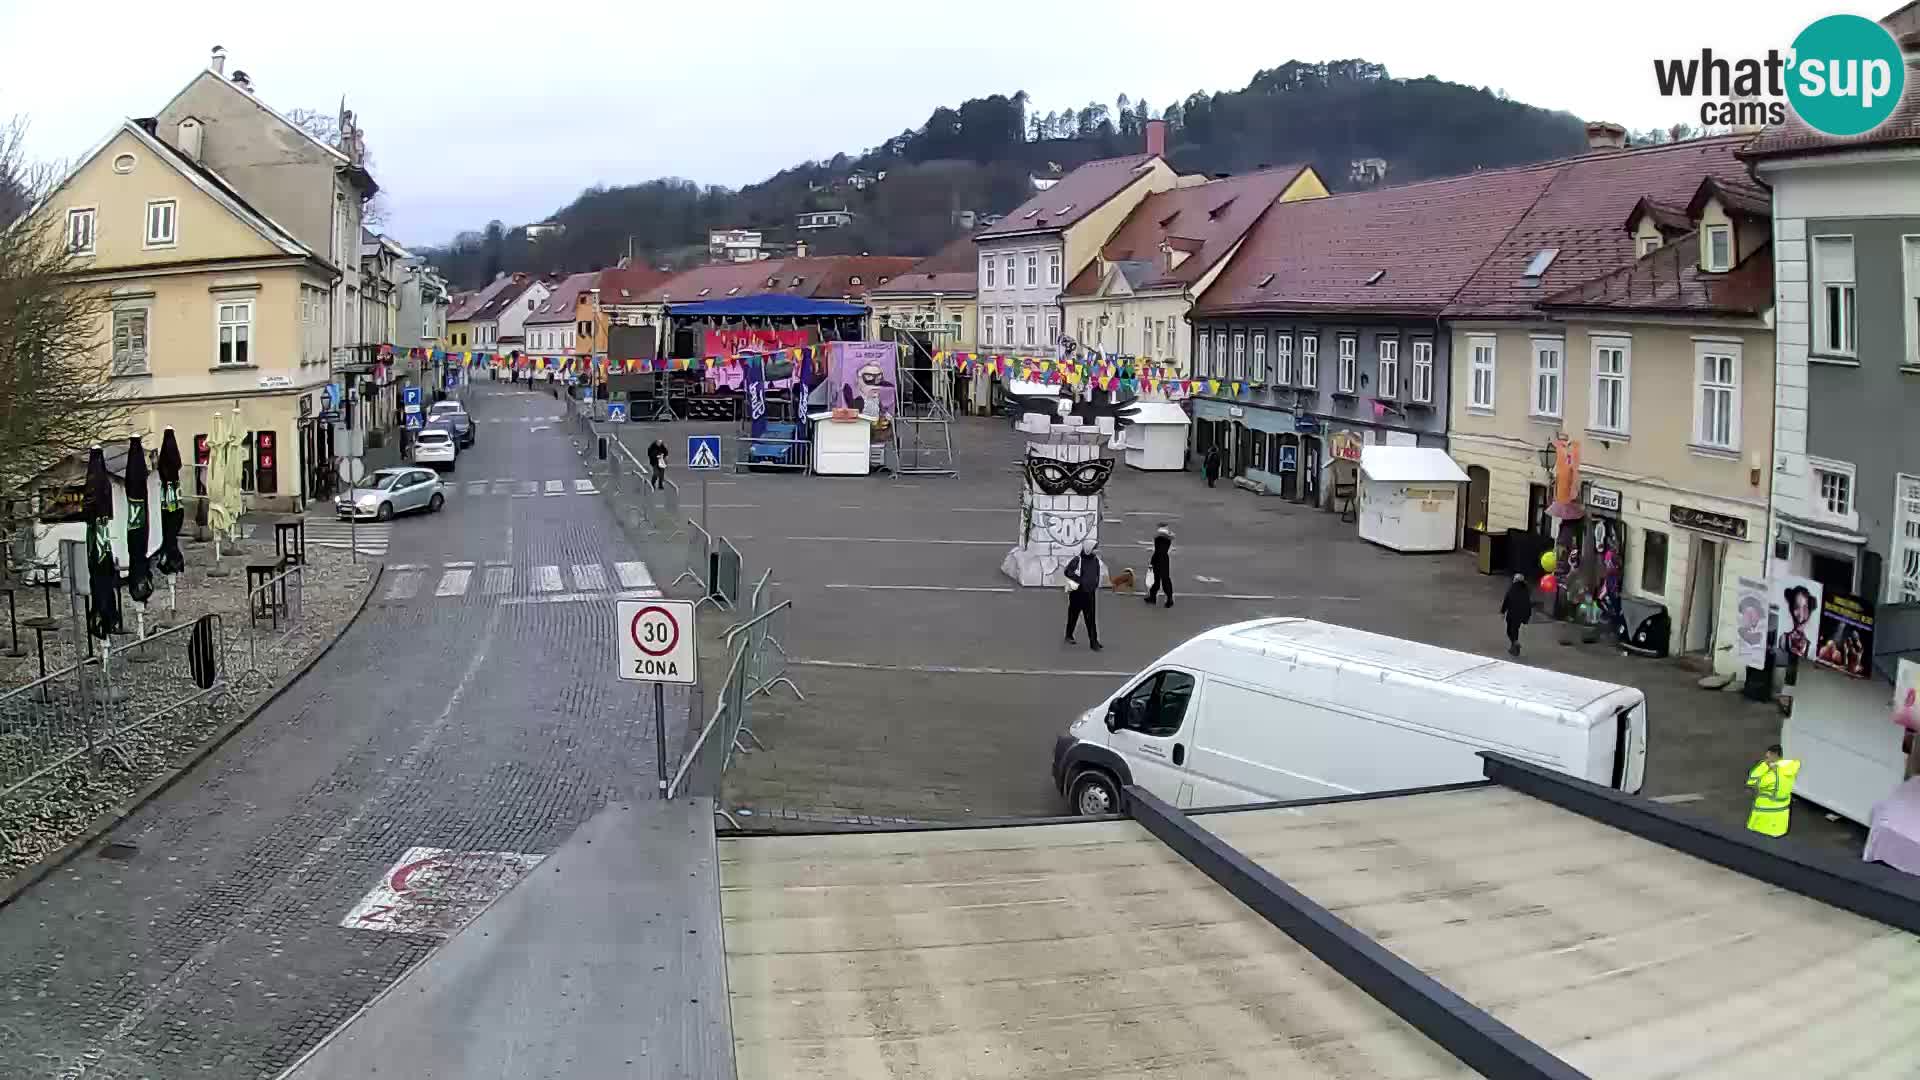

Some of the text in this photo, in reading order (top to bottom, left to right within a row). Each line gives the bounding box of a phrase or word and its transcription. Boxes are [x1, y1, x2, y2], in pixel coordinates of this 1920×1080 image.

[407, 391, 416, 403] P
[1050, 517, 1088, 545] 200
[643, 621, 668, 643] 30
[634, 659, 679, 676] ZONA
